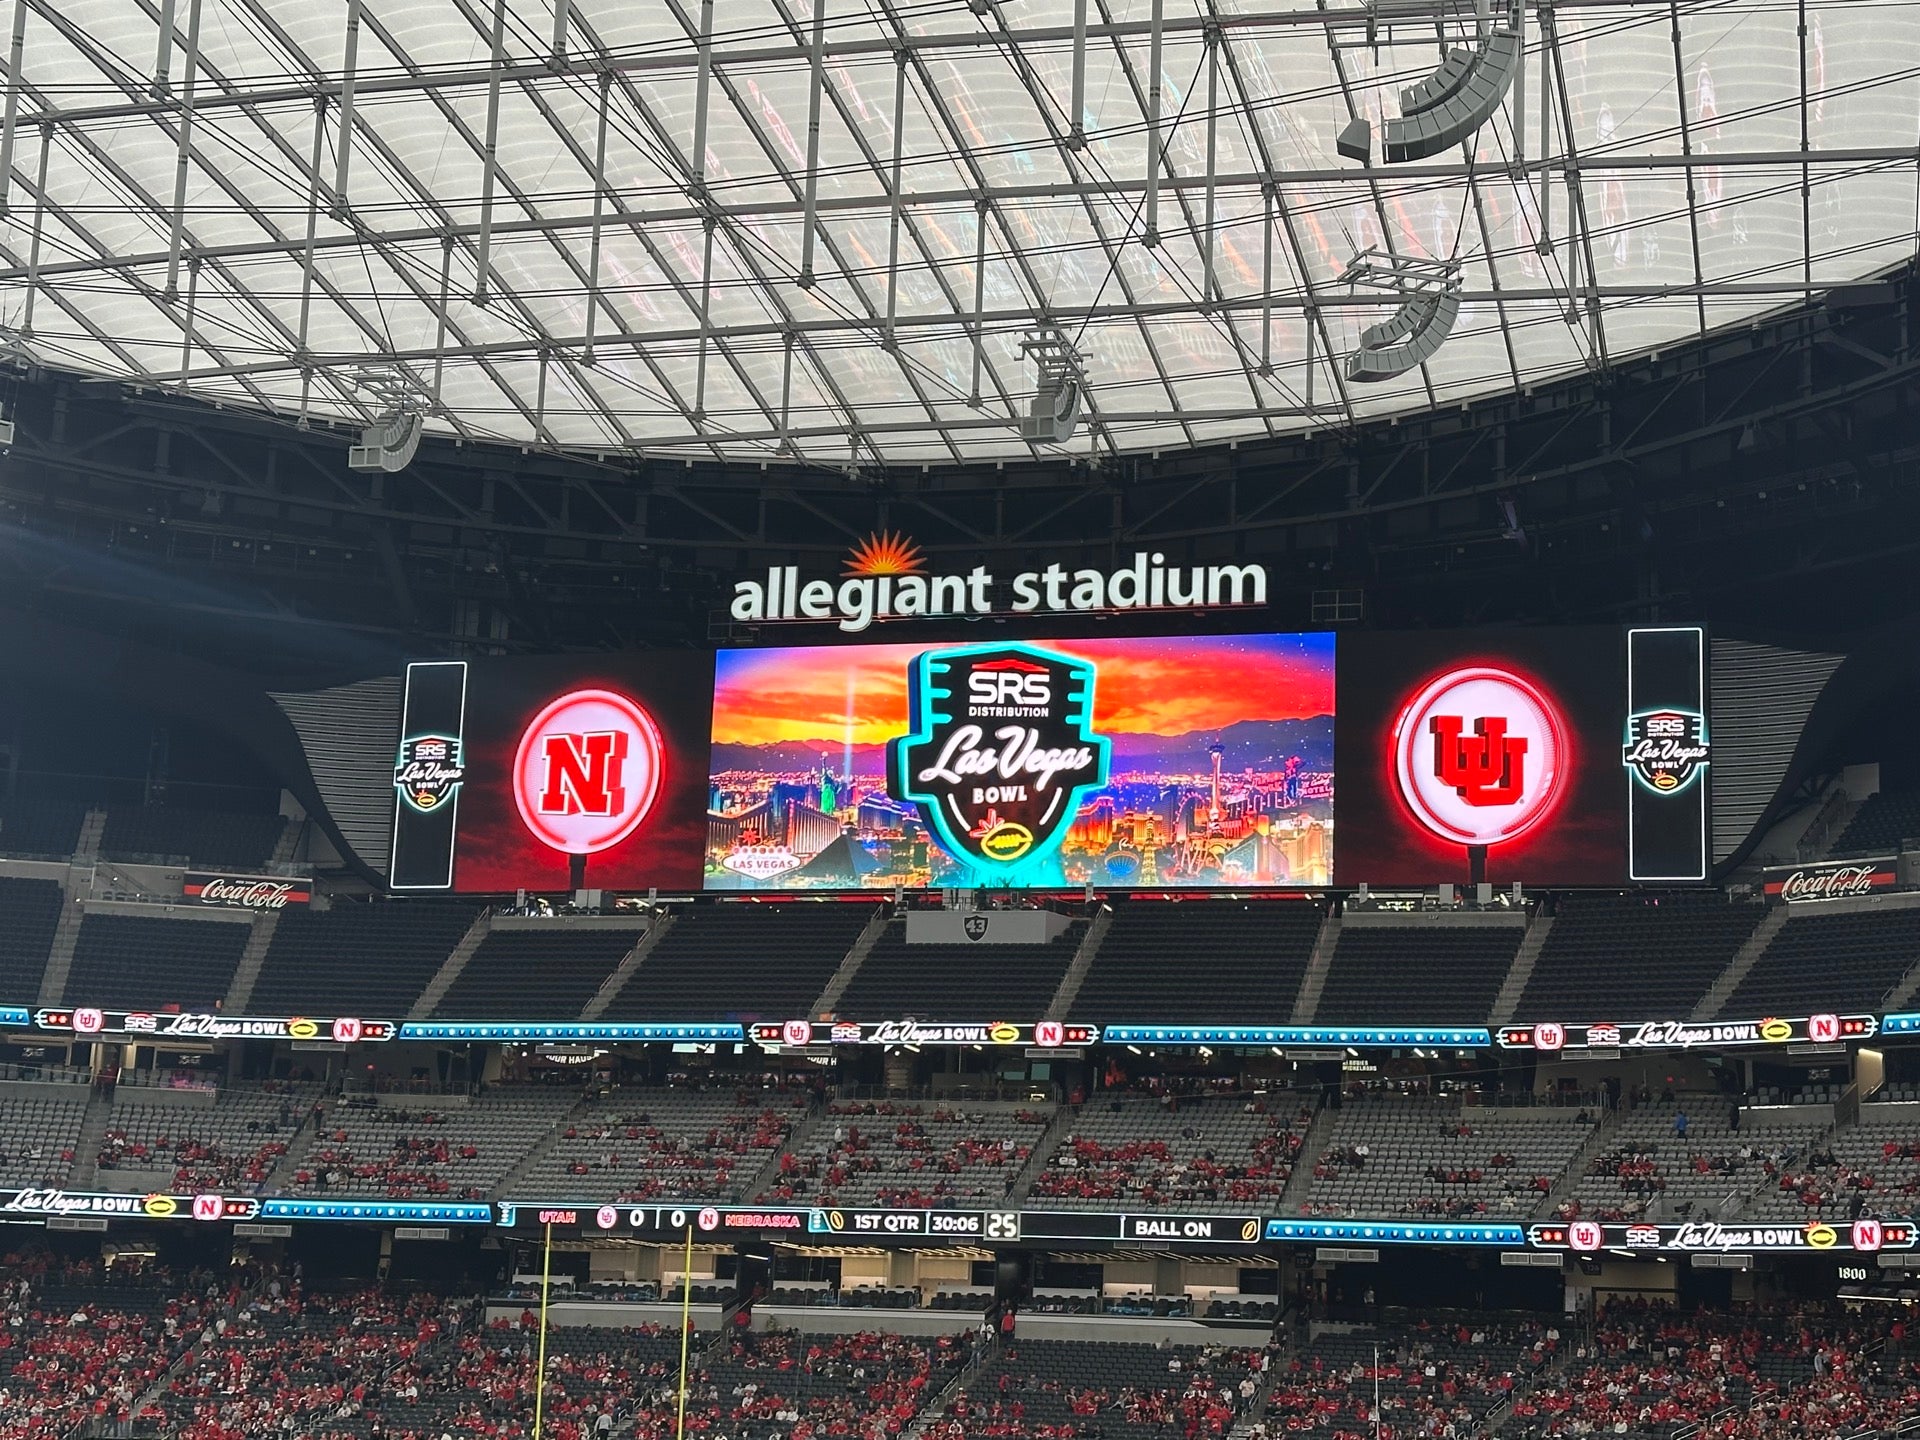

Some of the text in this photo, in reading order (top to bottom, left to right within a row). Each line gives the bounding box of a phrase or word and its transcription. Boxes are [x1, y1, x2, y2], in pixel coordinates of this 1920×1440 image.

[730, 552, 1267, 632] allegiant stadium
[969, 671, 1050, 705] SRS
[968, 706, 1049, 717] DISTRIBUTION
[1647, 719, 1684, 732] SRS
[415, 744, 446, 756] SRS
[918, 724, 1092, 792] Las Vegas
[1626, 739, 1707, 765] Las Vegas
[397, 762, 462, 785] Las Vegas
[538, 730, 628, 817] N
[1651, 761, 1679, 769] BOWL
[972, 785, 1027, 804] BOWL
[733, 860, 793, 869] LAS VEGAS
[1781, 865, 1877, 901] Coca-Cola
[200, 879, 295, 908] Coca-Cola
[966, 920, 985, 933] 43
[124, 1016, 157, 1028] SRS
[163, 1013, 286, 1038] Las Vegas BOWL
[340, 1023, 355, 1037] N
[1817, 1020, 1831, 1036] N
[830, 1026, 861, 1038] SRS
[868, 1020, 988, 1045] Las Vegas BOWL
[1043, 1027, 1057, 1040] N
[1587, 1029, 1620, 1041] SRS
[1629, 1021, 1759, 1047] Las Vegas BOWL
[6, 1187, 141, 1215] Las Vegas BOWL
[200, 1200, 215, 1214] N
[539, 1211, 577, 1223] UTAH
[629, 1209, 645, 1227] 0
[670, 1209, 686, 1228] 0
[725, 1214, 801, 1228] NEBRASKA
[854, 1214, 919, 1232] 1ST QTR
[932, 1216, 979, 1231] 30:06
[988, 1213, 1017, 1237] 25
[1135, 1220, 1211, 1237] BALL ON
[1626, 1229, 1660, 1243] SRS
[1667, 1222, 1804, 1251] Las Vegas BOWL
[1860, 1227, 1875, 1244] N
[1838, 1267, 1867, 1280] 1800
